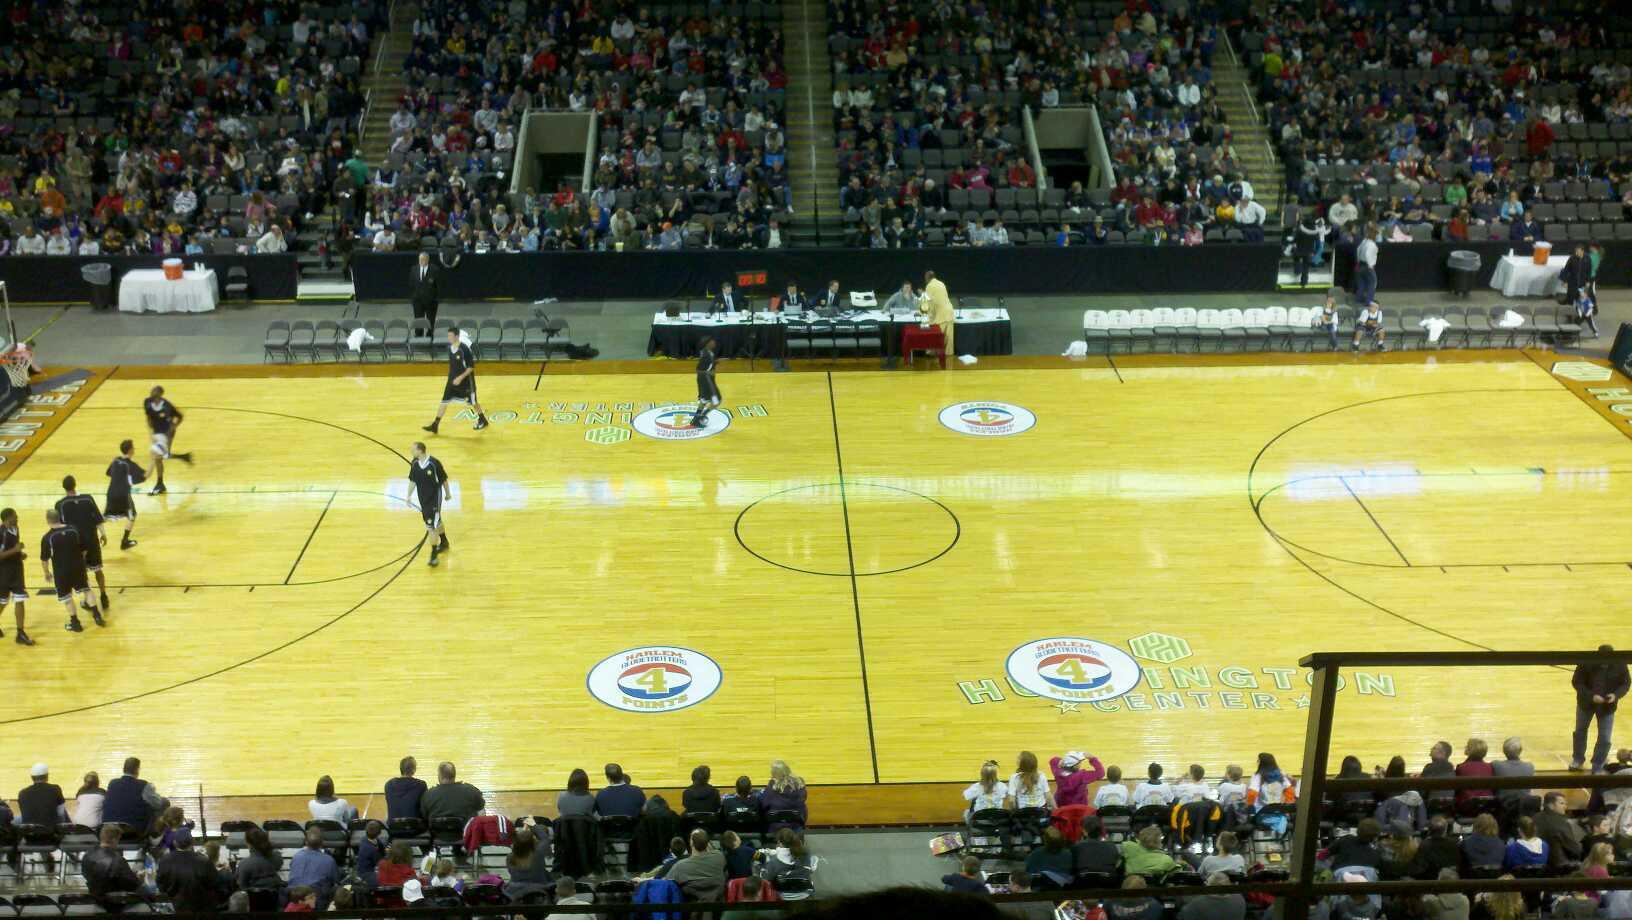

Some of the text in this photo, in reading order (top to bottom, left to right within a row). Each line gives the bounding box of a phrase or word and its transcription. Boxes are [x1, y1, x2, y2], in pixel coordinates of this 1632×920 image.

[1036, 641, 1093, 651] HARLEM
[625, 649, 684, 661] HARLEM
[1056, 658, 1087, 684] 4
[636, 667, 668, 693] 4
[1050, 684, 1115, 698] POINTS
[621, 693, 689, 709] POINTS
